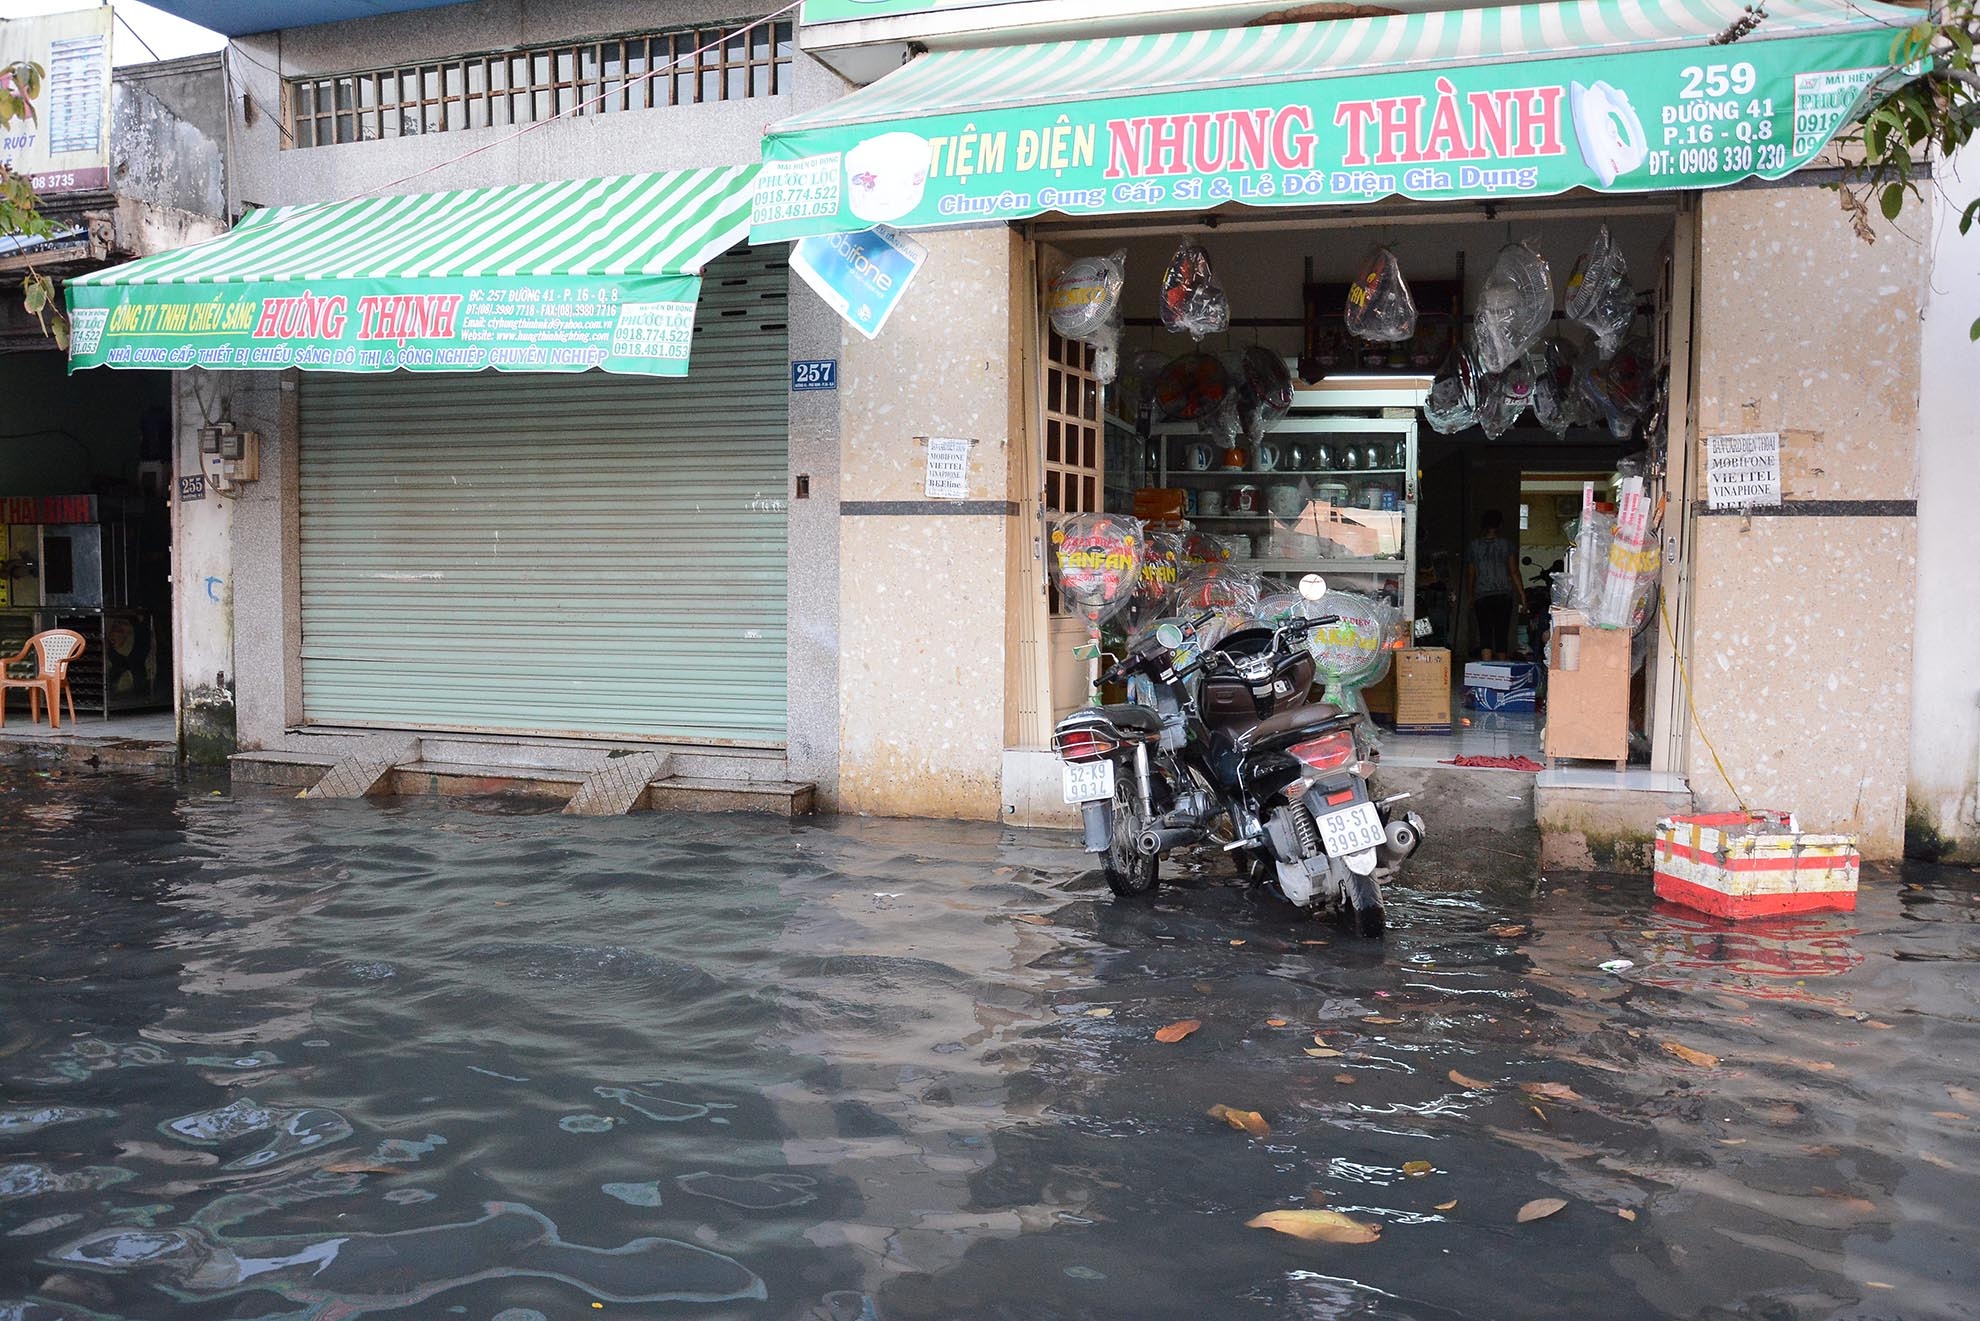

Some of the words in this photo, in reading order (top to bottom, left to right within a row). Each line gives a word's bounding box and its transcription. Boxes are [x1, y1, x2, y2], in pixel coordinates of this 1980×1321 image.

[1679, 62, 1757, 99] 259
[1797, 87, 1859, 111] PHƯỚ
[1661, 97, 1740, 125] ĐƯỜNG
[1746, 98, 1775, 118] 41
[927, 123, 1008, 185] TIỆM
[1015, 114, 1096, 178] ĐIỆN
[1103, 105, 1317, 179] NHUNG
[1333, 76, 1566, 169] THÀNH
[1663, 125, 1713, 146] P.16
[1735, 121, 1773, 142] Q.8
[1649, 150, 1675, 176] ĐT:
[1679, 147, 1718, 174] 0908
[1722, 145, 1752, 172] 330
[1756, 143, 1786, 170] 230
[48, 173, 75, 188] 3735
[938, 192, 1030, 216] Chuyên
[1038, 186, 1106, 208] Cung
[1113, 178, 1164, 204] Cấp
[1209, 178, 1231, 198] &
[1241, 171, 1274, 197] Lẻ
[1332, 168, 1395, 197] Điện
[1404, 168, 1450, 190] Gia
[1460, 166, 1537, 194] Dụng
[755, 185, 837, 206] 0918.774.522
[753, 201, 837, 224] 0918.481.053
[826, 233, 893, 291] obifone
[487, 290, 507, 302] 257
[542, 289, 555, 302] 41
[577, 288, 589, 302] 16
[611, 288, 618, 301] 8
[109, 298, 141, 332] CÔNG
[139, 303, 159, 331] TY
[160, 303, 192, 331] TNHH
[192, 291, 223, 332] CHIẾU
[222, 295, 256, 332] SÁNG
[252, 290, 348, 339] HƯNG
[358, 294, 463, 347] THỊNH
[516, 303, 535, 316] 7718
[596, 303, 617, 317] 7716
[615, 327, 690, 343] 0918.774.522
[107, 344, 131, 362] NHÀ
[134, 348, 166, 362] CUNG
[169, 343, 195, 362] CẤP
[198, 343, 234, 363] THIẾT
[235, 347, 249, 365] BỊ
[251, 342, 291, 364] CHIẾU
[294, 344, 331, 364] SÁNG
[334, 346, 355, 365] ĐÔ
[359, 350, 381, 368] THỊ
[383, 350, 395, 366] &
[397, 345, 433, 365] CÔNG
[435, 345, 487, 367] NGHIỆP
[489, 345, 547, 365] CHUYÊN
[550, 345, 608, 369] NGHIỆP
[614, 342, 689, 357] 0918.481.053
[796, 363, 832, 382] 257
[929, 462, 965, 471] VIETTEL
[1712, 456, 1775, 469] MOBIFONE
[182, 477, 203, 494] 255
[1713, 471, 1776, 483] VIETTEL
[1713, 484, 1771, 497] VINAPHONE
[1070, 764, 1105, 783] 52-K9
[1326, 808, 1369, 834] 59-S1
[1328, 824, 1382, 853] 399.98
